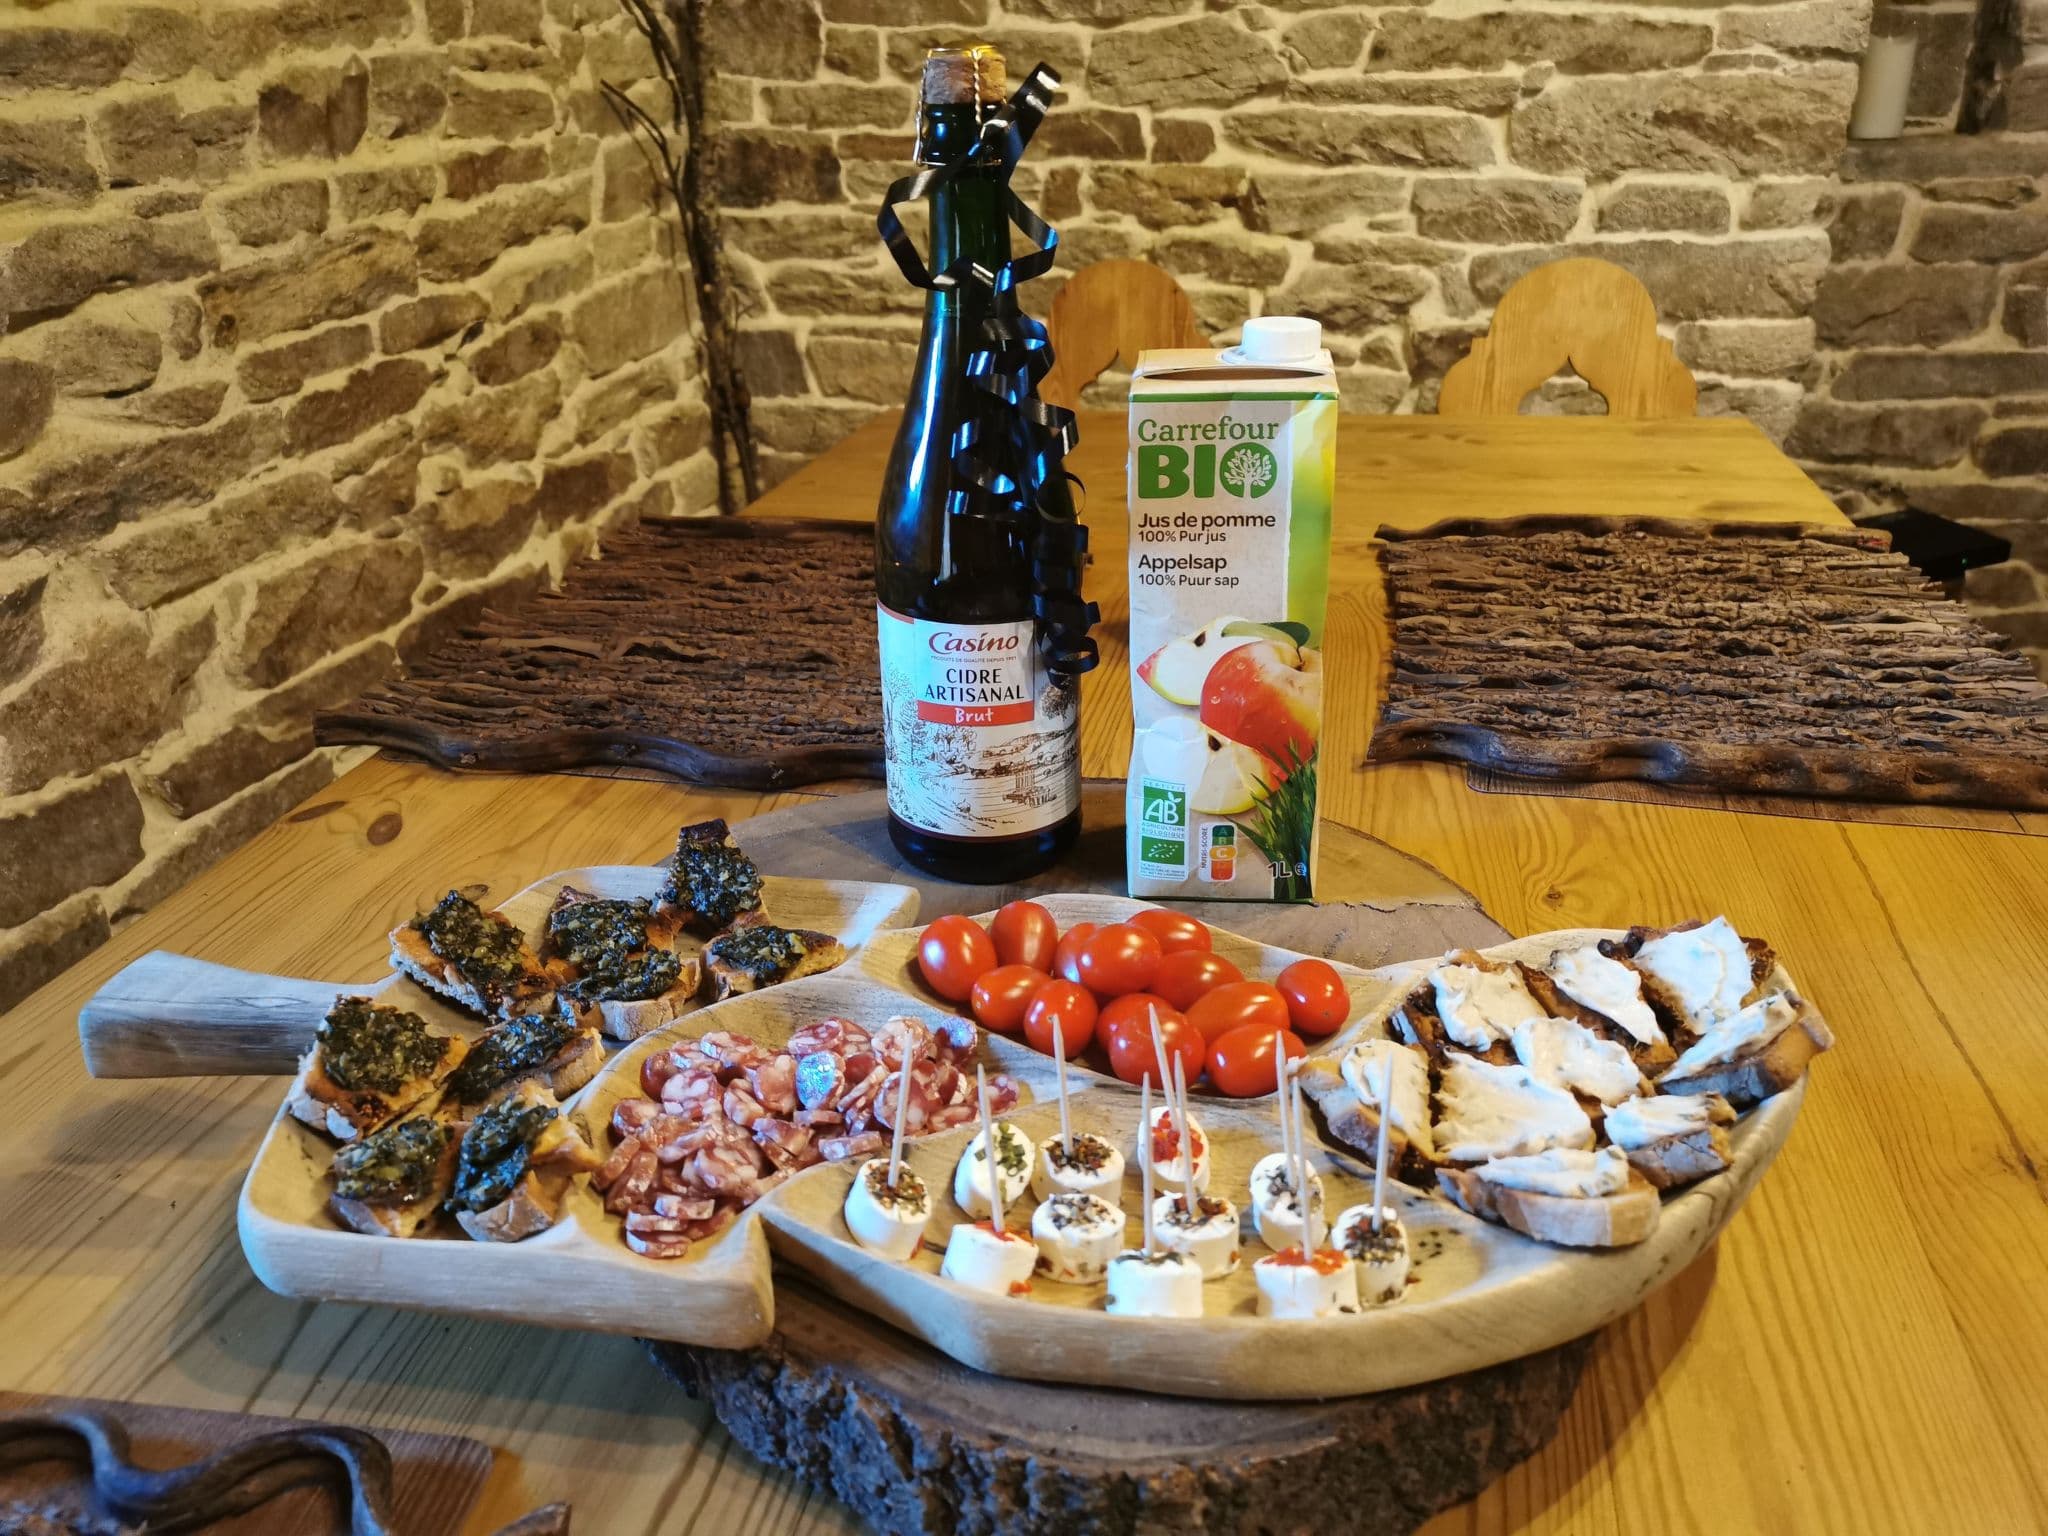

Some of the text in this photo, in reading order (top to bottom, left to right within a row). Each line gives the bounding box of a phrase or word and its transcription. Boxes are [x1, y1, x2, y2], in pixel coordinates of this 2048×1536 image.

[1138, 415, 1279, 442] Carrefour
[1138, 512, 1276, 531] Jus de pomme
[1138, 530, 1226, 545] 100% Pur jus
[1138, 554, 1227, 573] Appelsap
[1138, 574, 1240, 588] 100% Puur sap
[928, 631, 1019, 655] Casino
[946, 668, 1002, 684] CIDRE
[925, 684, 1025, 703] ARTISANAL
[954, 707, 994, 724] Brut
[1144, 797, 1179, 824] AB
[1217, 827, 1229, 836] A
[1216, 847, 1228, 859] C
[1266, 861, 1293, 879] 1L
